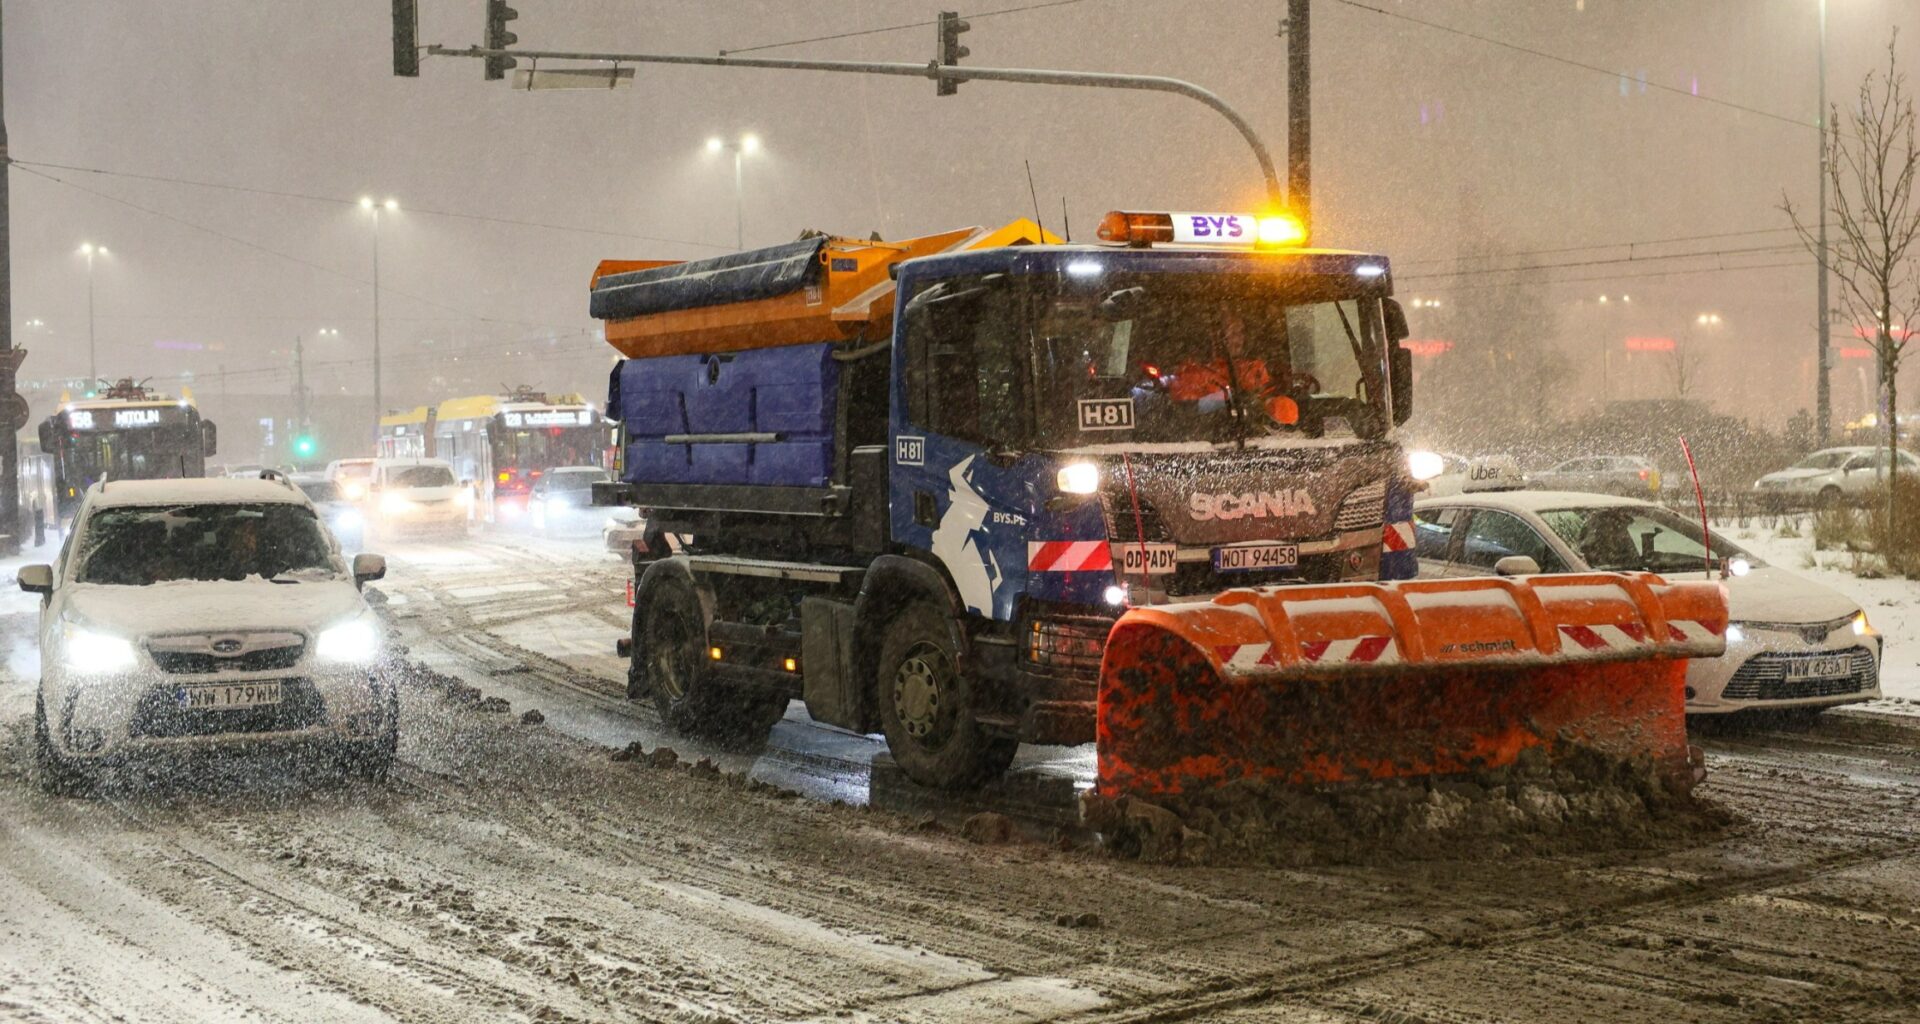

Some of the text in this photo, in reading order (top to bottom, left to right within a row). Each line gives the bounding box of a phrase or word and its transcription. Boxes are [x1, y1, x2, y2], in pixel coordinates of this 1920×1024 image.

[1085, 405, 1128, 424] H81
[899, 441, 921, 460] H81
[1471, 465, 1501, 481] Uber
[1190, 489, 1316, 521] SCANIA
[993, 511, 1027, 526] BYS.PL
[1126, 550, 1175, 568] ODPADY
[1222, 548, 1296, 567] WOT 94458
[1461, 639, 1517, 652] schmidt
[189, 685, 279, 706] WW 179WM
